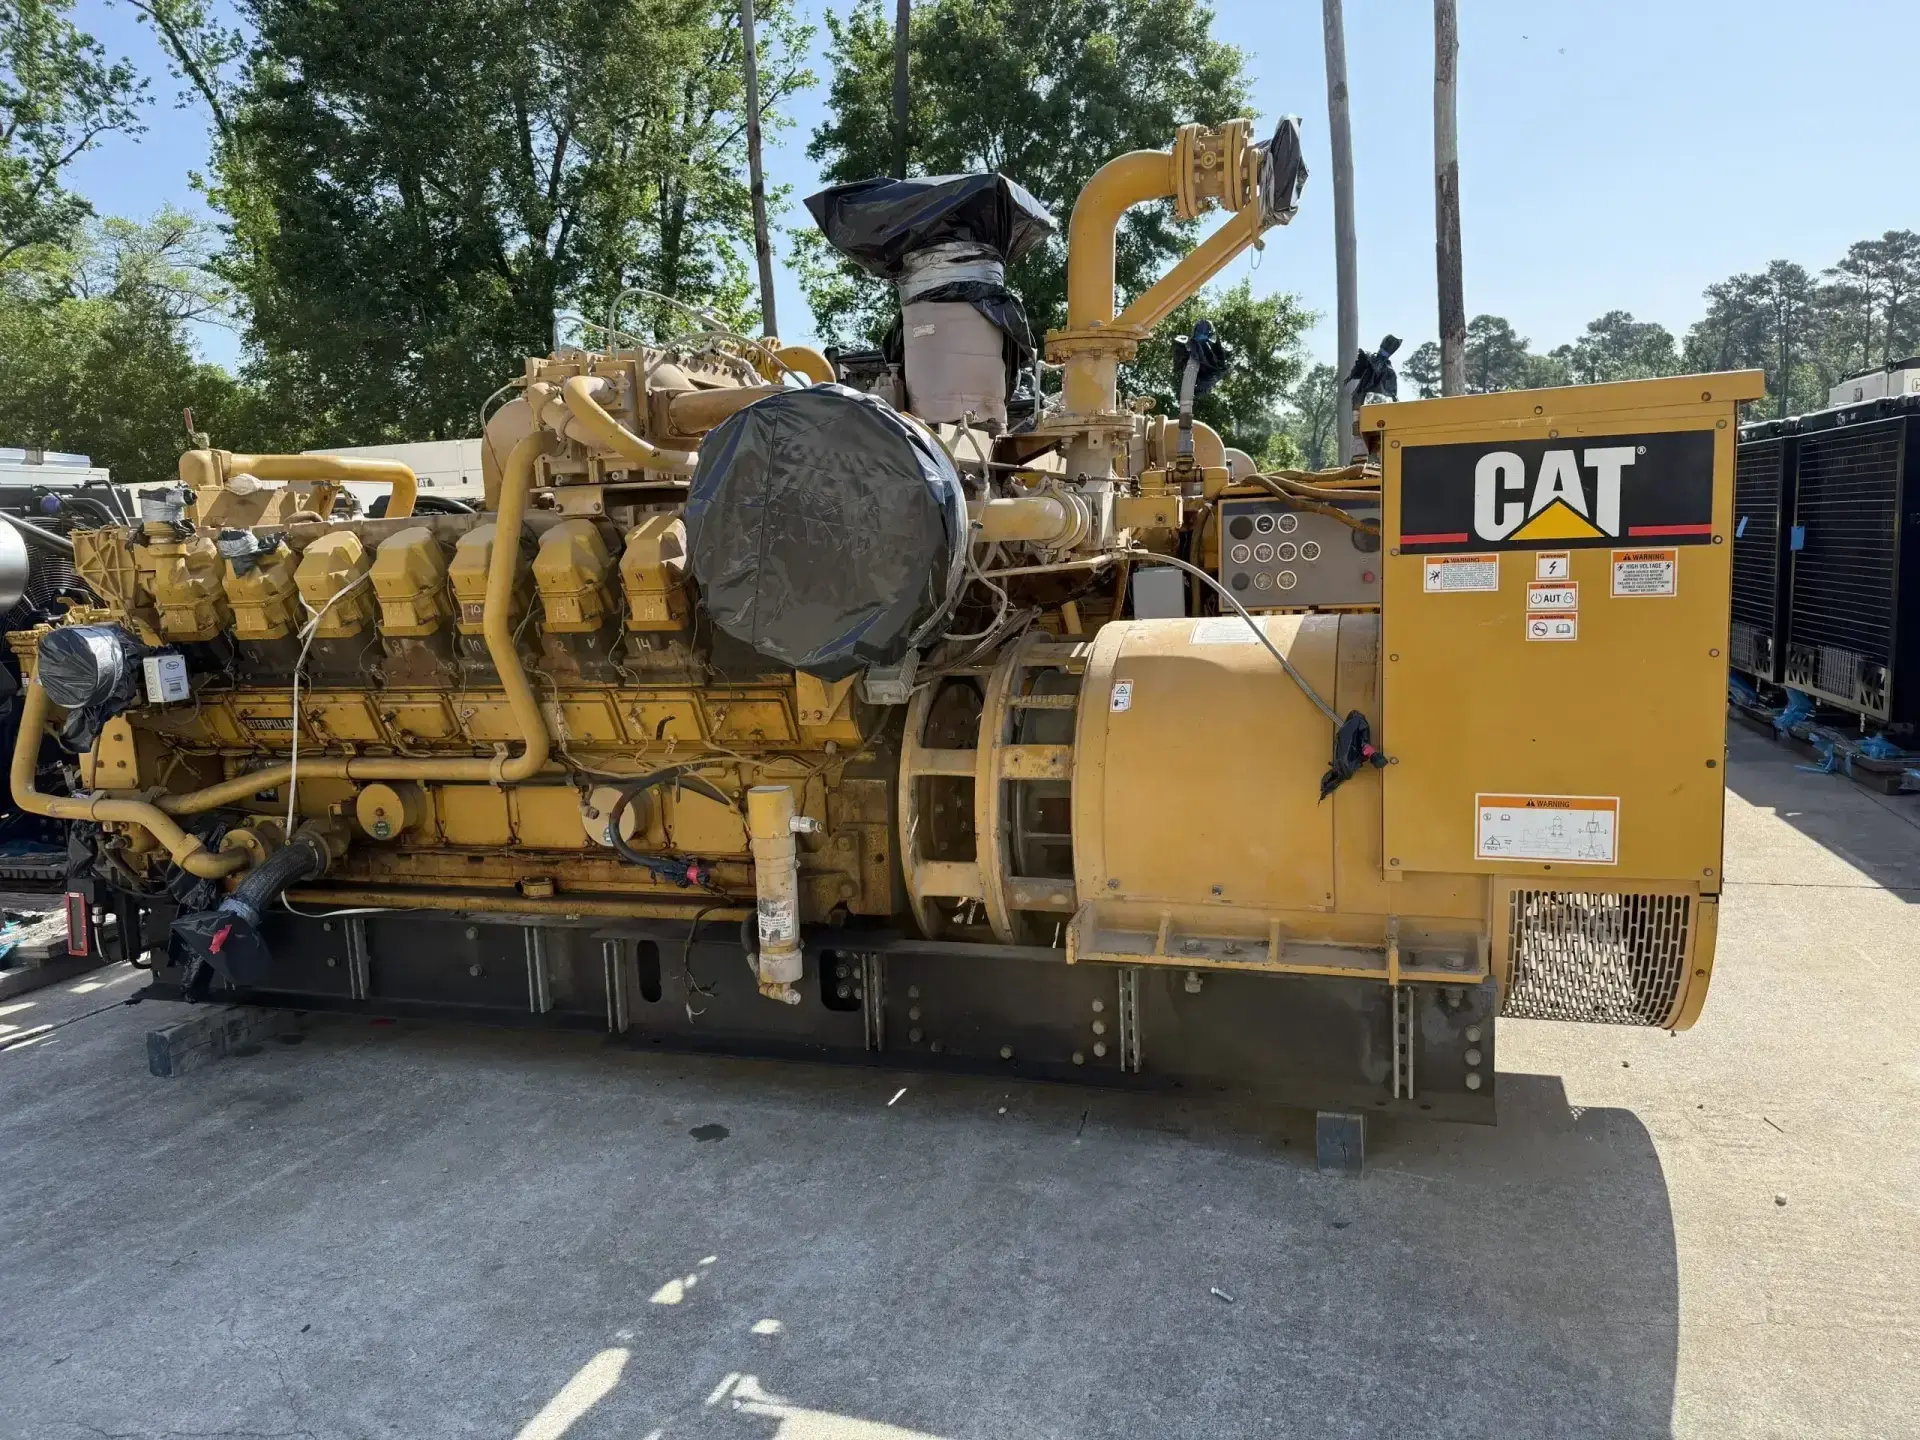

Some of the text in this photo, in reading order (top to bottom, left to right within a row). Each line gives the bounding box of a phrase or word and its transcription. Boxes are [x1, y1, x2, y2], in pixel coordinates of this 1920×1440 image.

[1474, 446, 1636, 541] CAT
[1632, 553, 1665, 561] WARNING
[1543, 594, 1561, 603] AUT
[470, 604, 481, 615] 10
[635, 637, 652, 652] 14
[1537, 800, 1570, 808] WARNING
